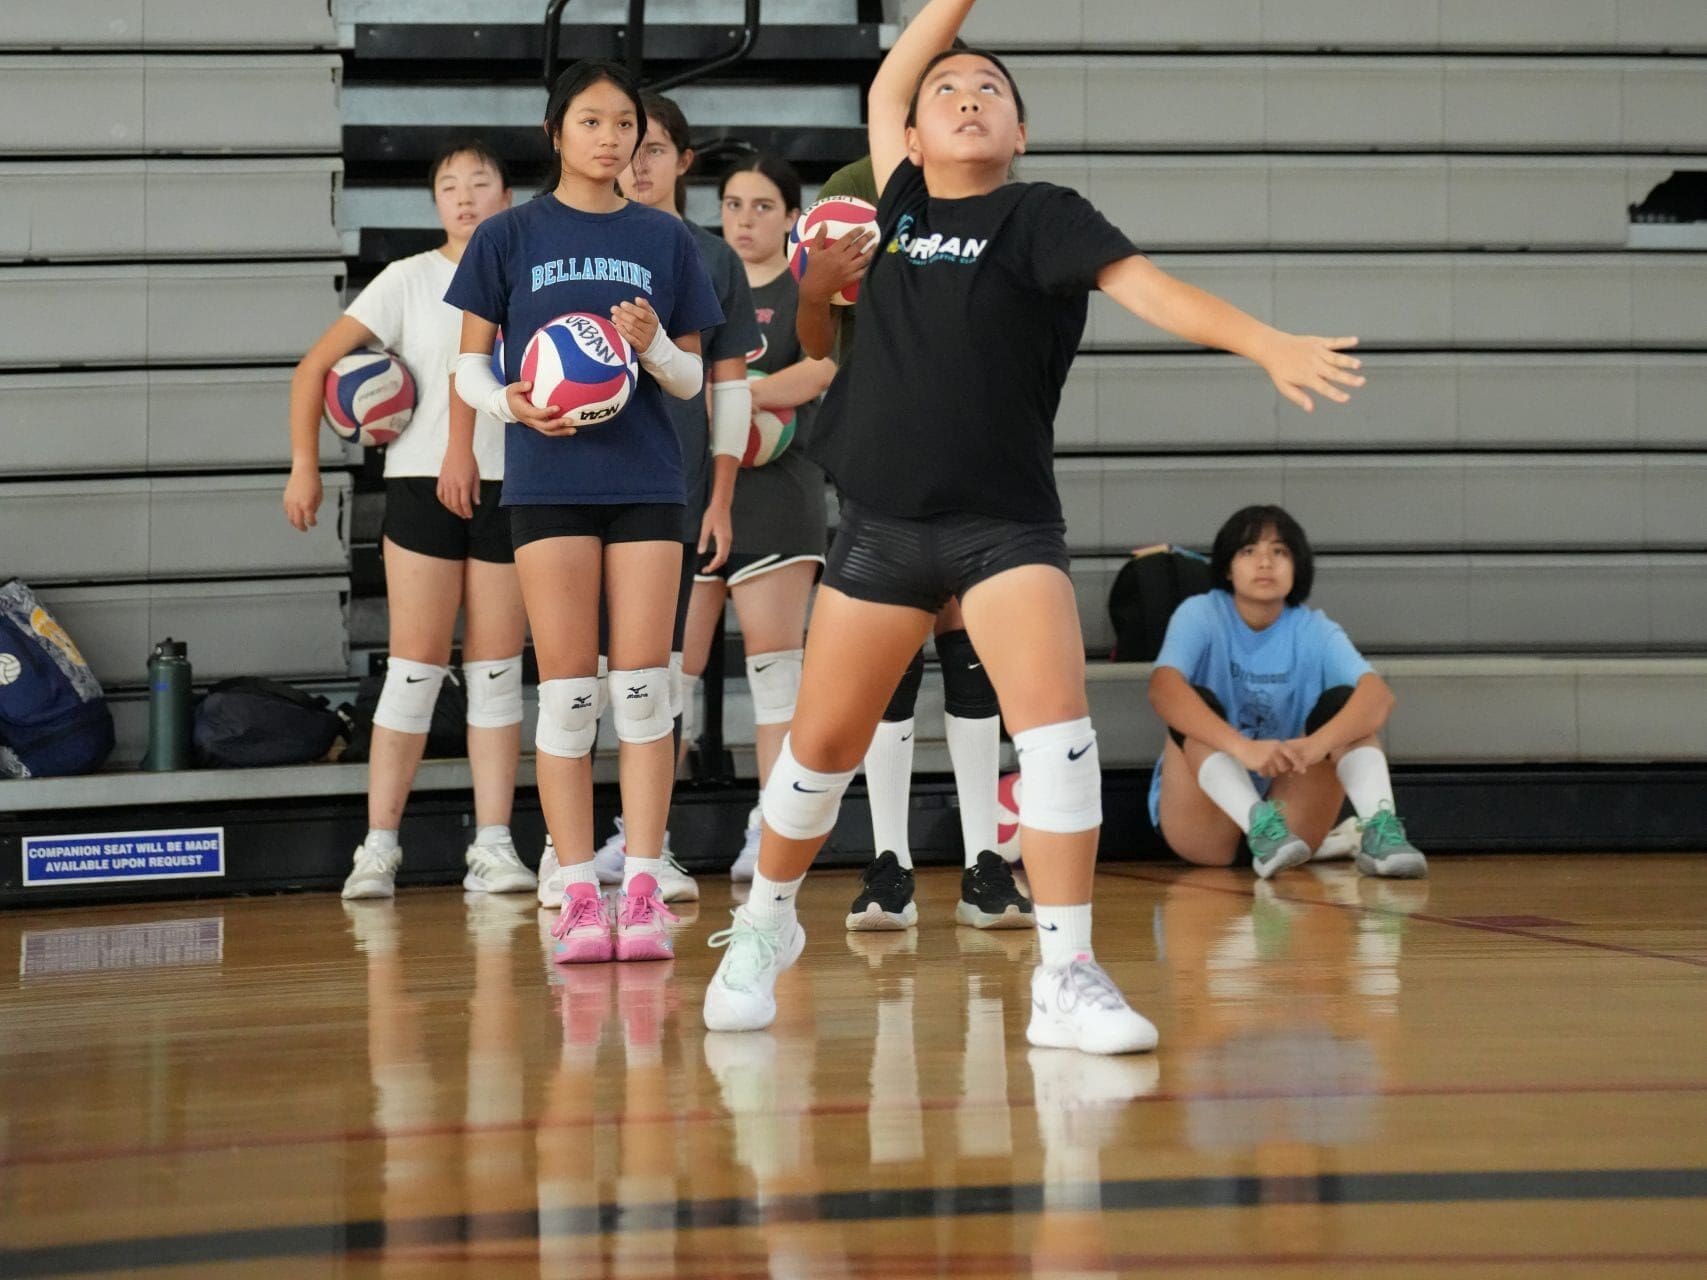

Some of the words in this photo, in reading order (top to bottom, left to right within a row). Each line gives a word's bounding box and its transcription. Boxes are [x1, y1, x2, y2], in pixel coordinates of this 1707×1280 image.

[899, 233, 988, 260] URBAN
[531, 257, 653, 295] BELLARMINE
[565, 316, 616, 363] URBAN
[580, 403, 620, 421] NCAA
[28, 845, 101, 859] COMPANION
[103, 844, 133, 855] SEAT
[135, 842, 164, 854] WILL
[167, 841, 182, 852] BE
[185, 840, 218, 851] MADE
[45, 861, 109, 873] AVAILABLE
[112, 857, 146, 869] UPON
[149, 855, 203, 867] REQUEST
